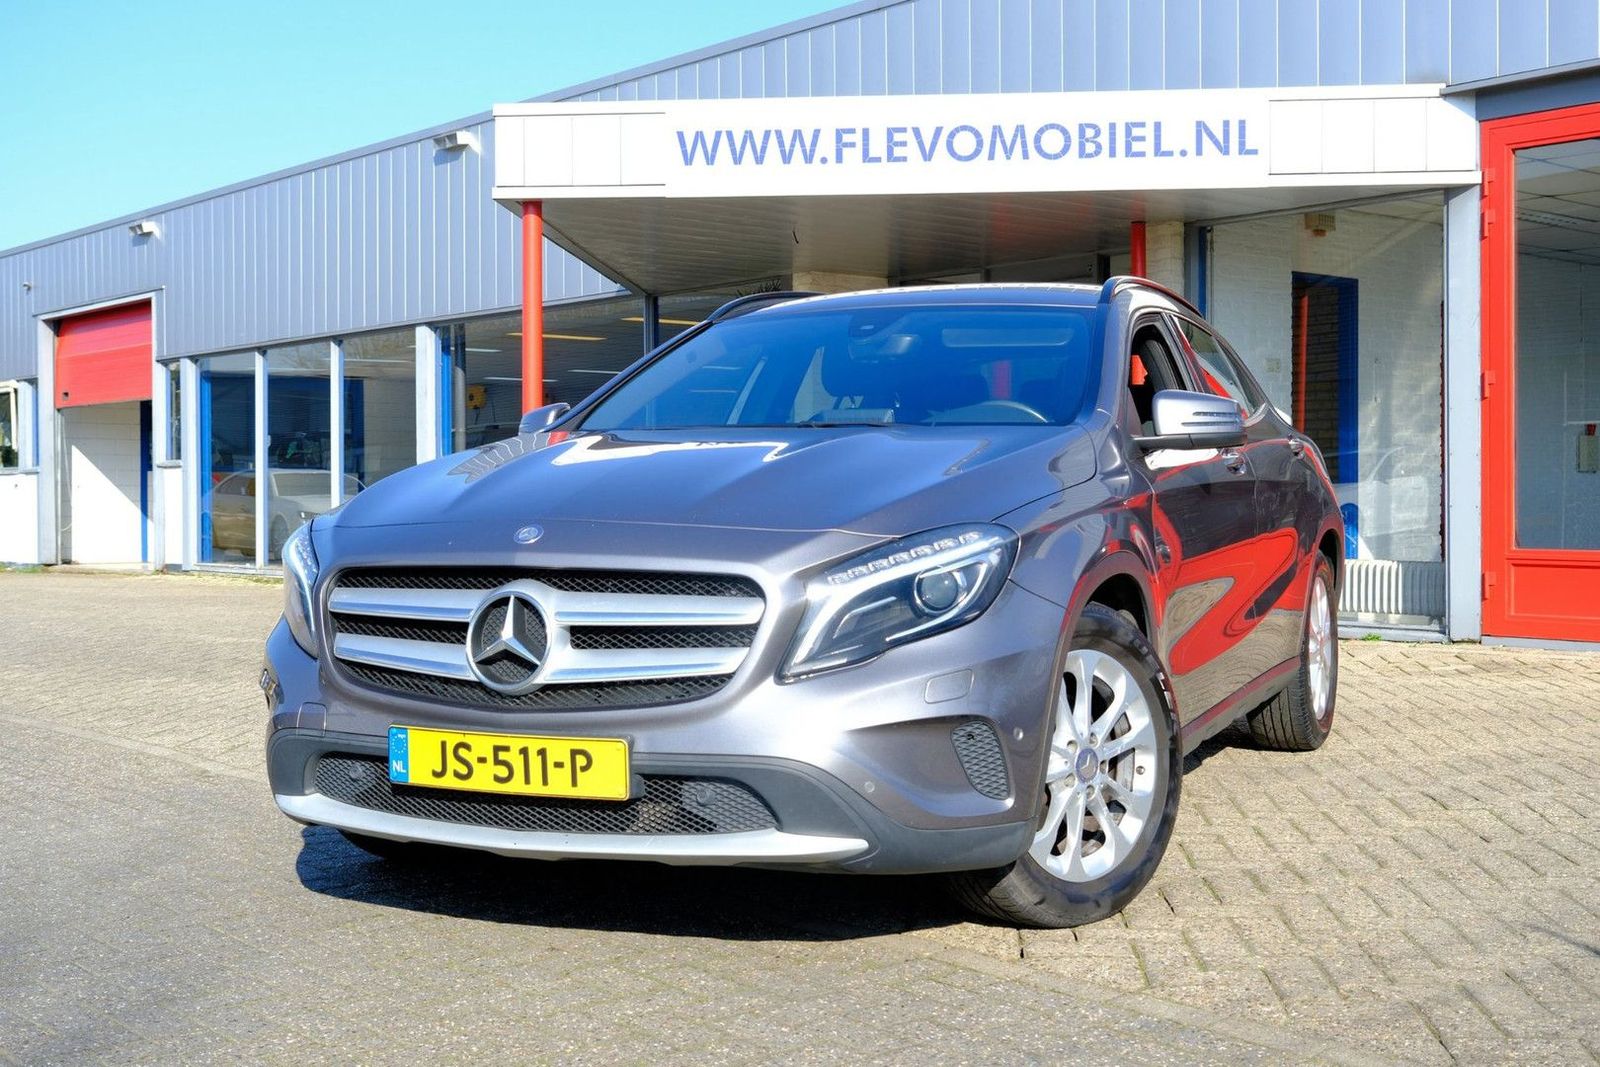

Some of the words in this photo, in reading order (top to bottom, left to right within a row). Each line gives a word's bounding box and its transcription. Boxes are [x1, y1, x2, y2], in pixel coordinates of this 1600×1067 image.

[676, 119, 1259, 166] WWW.FLEVOMOBIEL.NL
[392, 759, 407, 773] NL
[431, 740, 593, 788] JS-511-P
